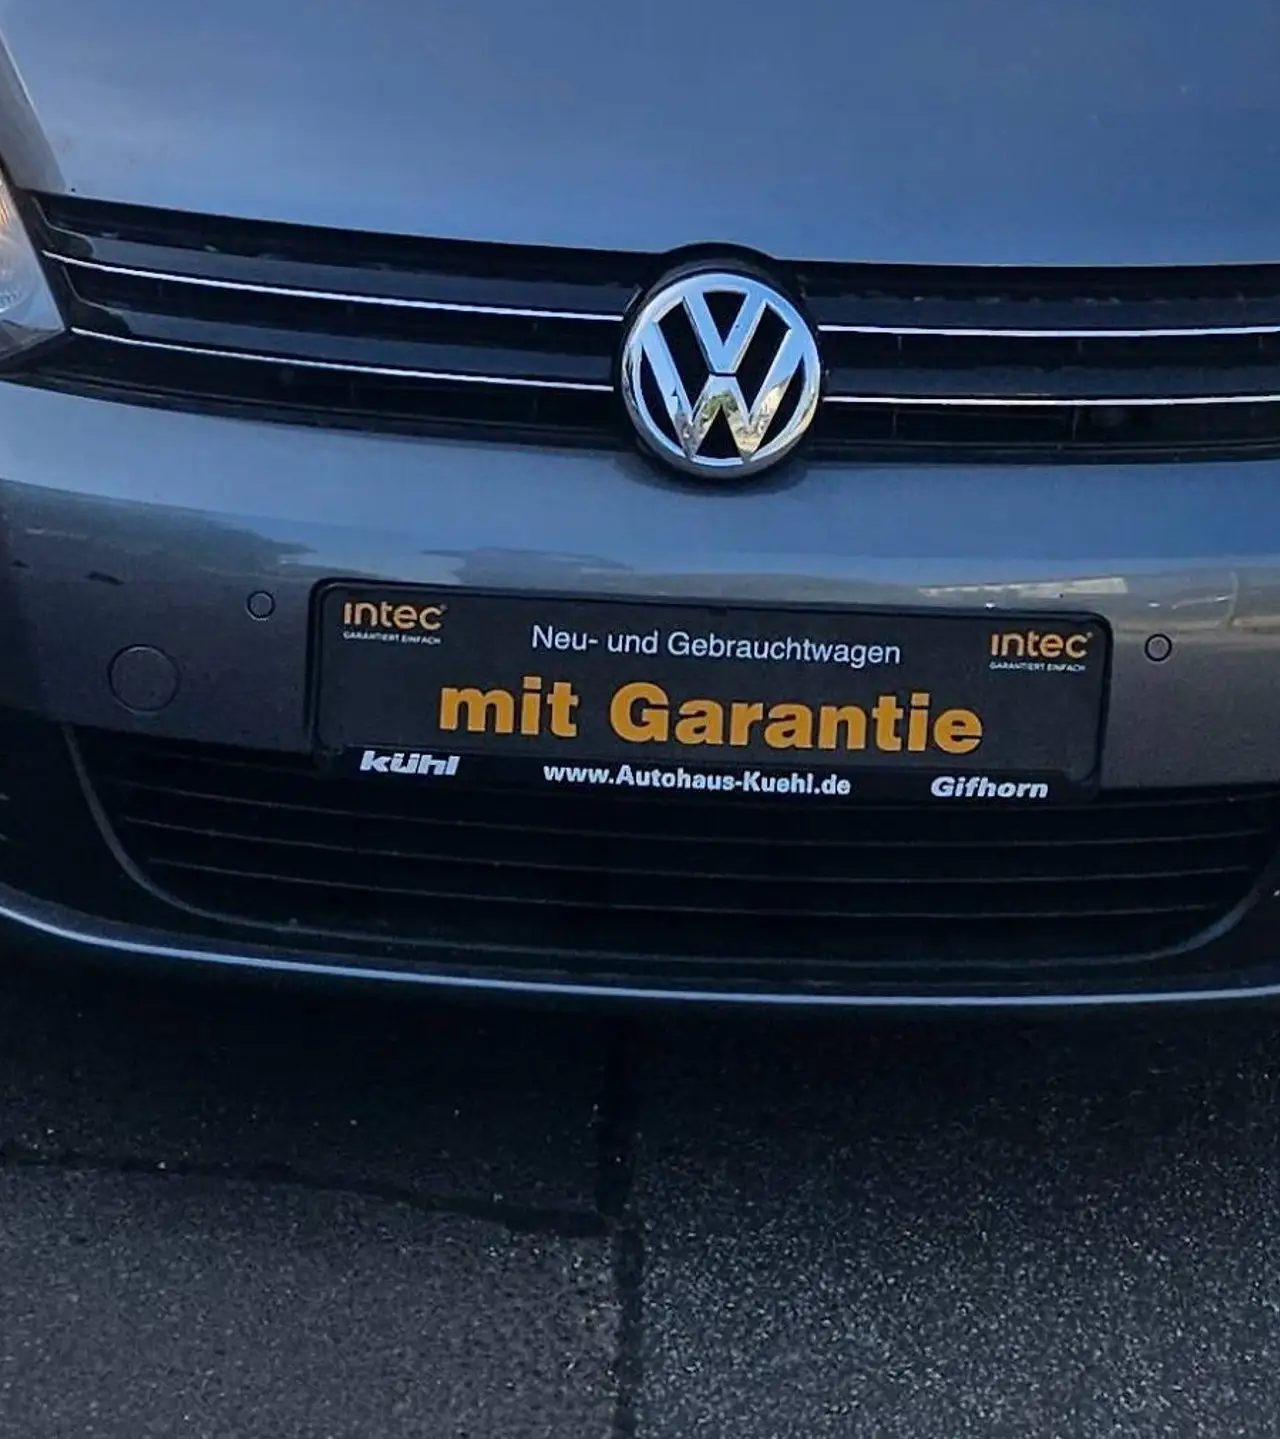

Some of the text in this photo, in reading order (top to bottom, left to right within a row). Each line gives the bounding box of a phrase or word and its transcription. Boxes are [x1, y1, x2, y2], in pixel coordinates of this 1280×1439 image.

[531, 625, 901, 668] Neu- und Gebrauchtwagen
[439, 675, 983, 755] mit Garantie
[543, 763, 852, 795] www.Autohaus-Kuehl.de
[930, 775, 1049, 799] Gifhorn
